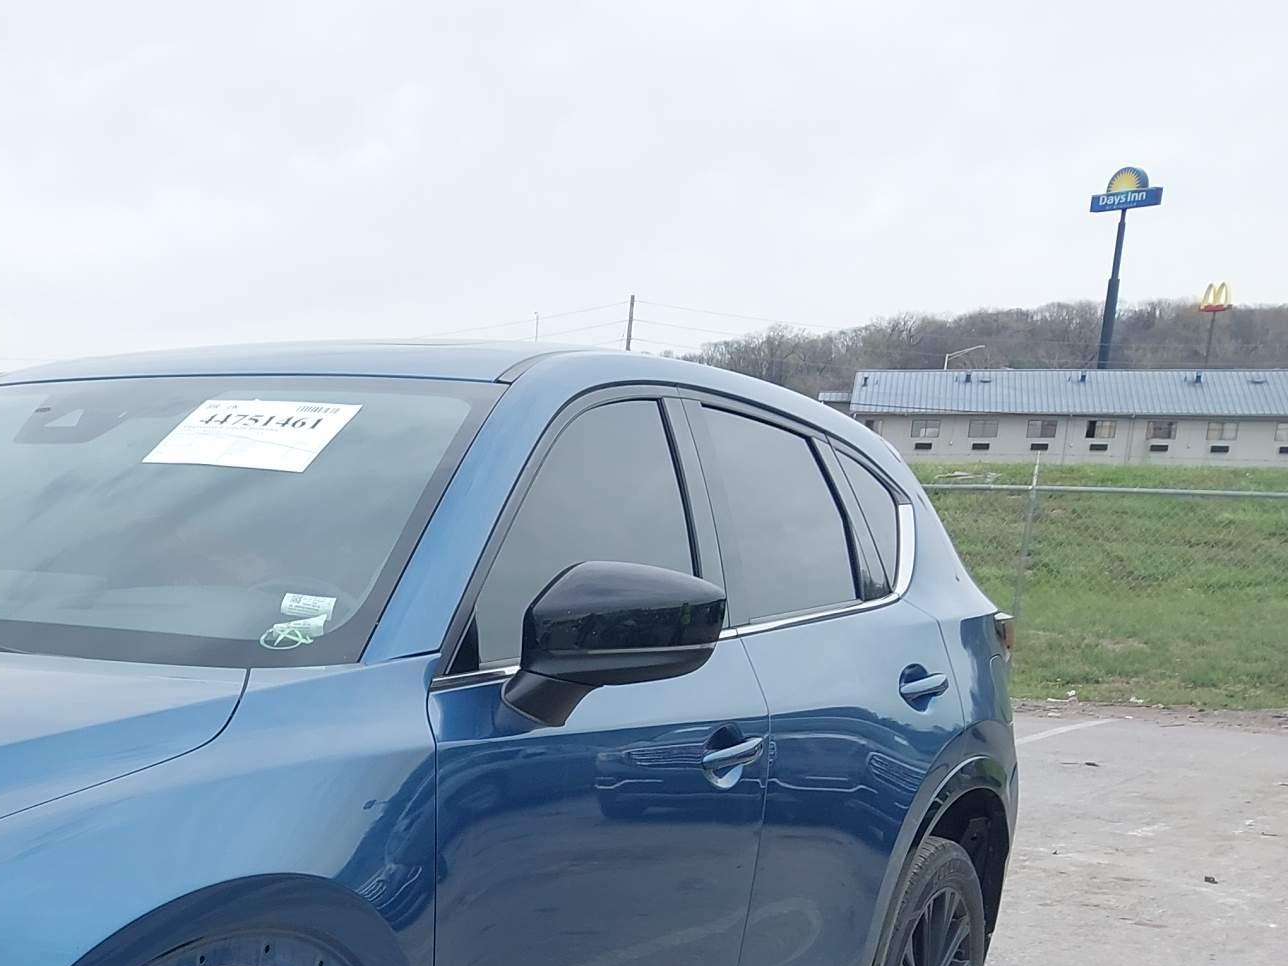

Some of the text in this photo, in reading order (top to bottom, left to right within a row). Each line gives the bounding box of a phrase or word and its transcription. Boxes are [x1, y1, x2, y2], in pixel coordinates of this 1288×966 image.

[1099, 193, 1126, 206] Days
[1127, 191, 1146, 202] Inn
[199, 413, 324, 430] 44751461
